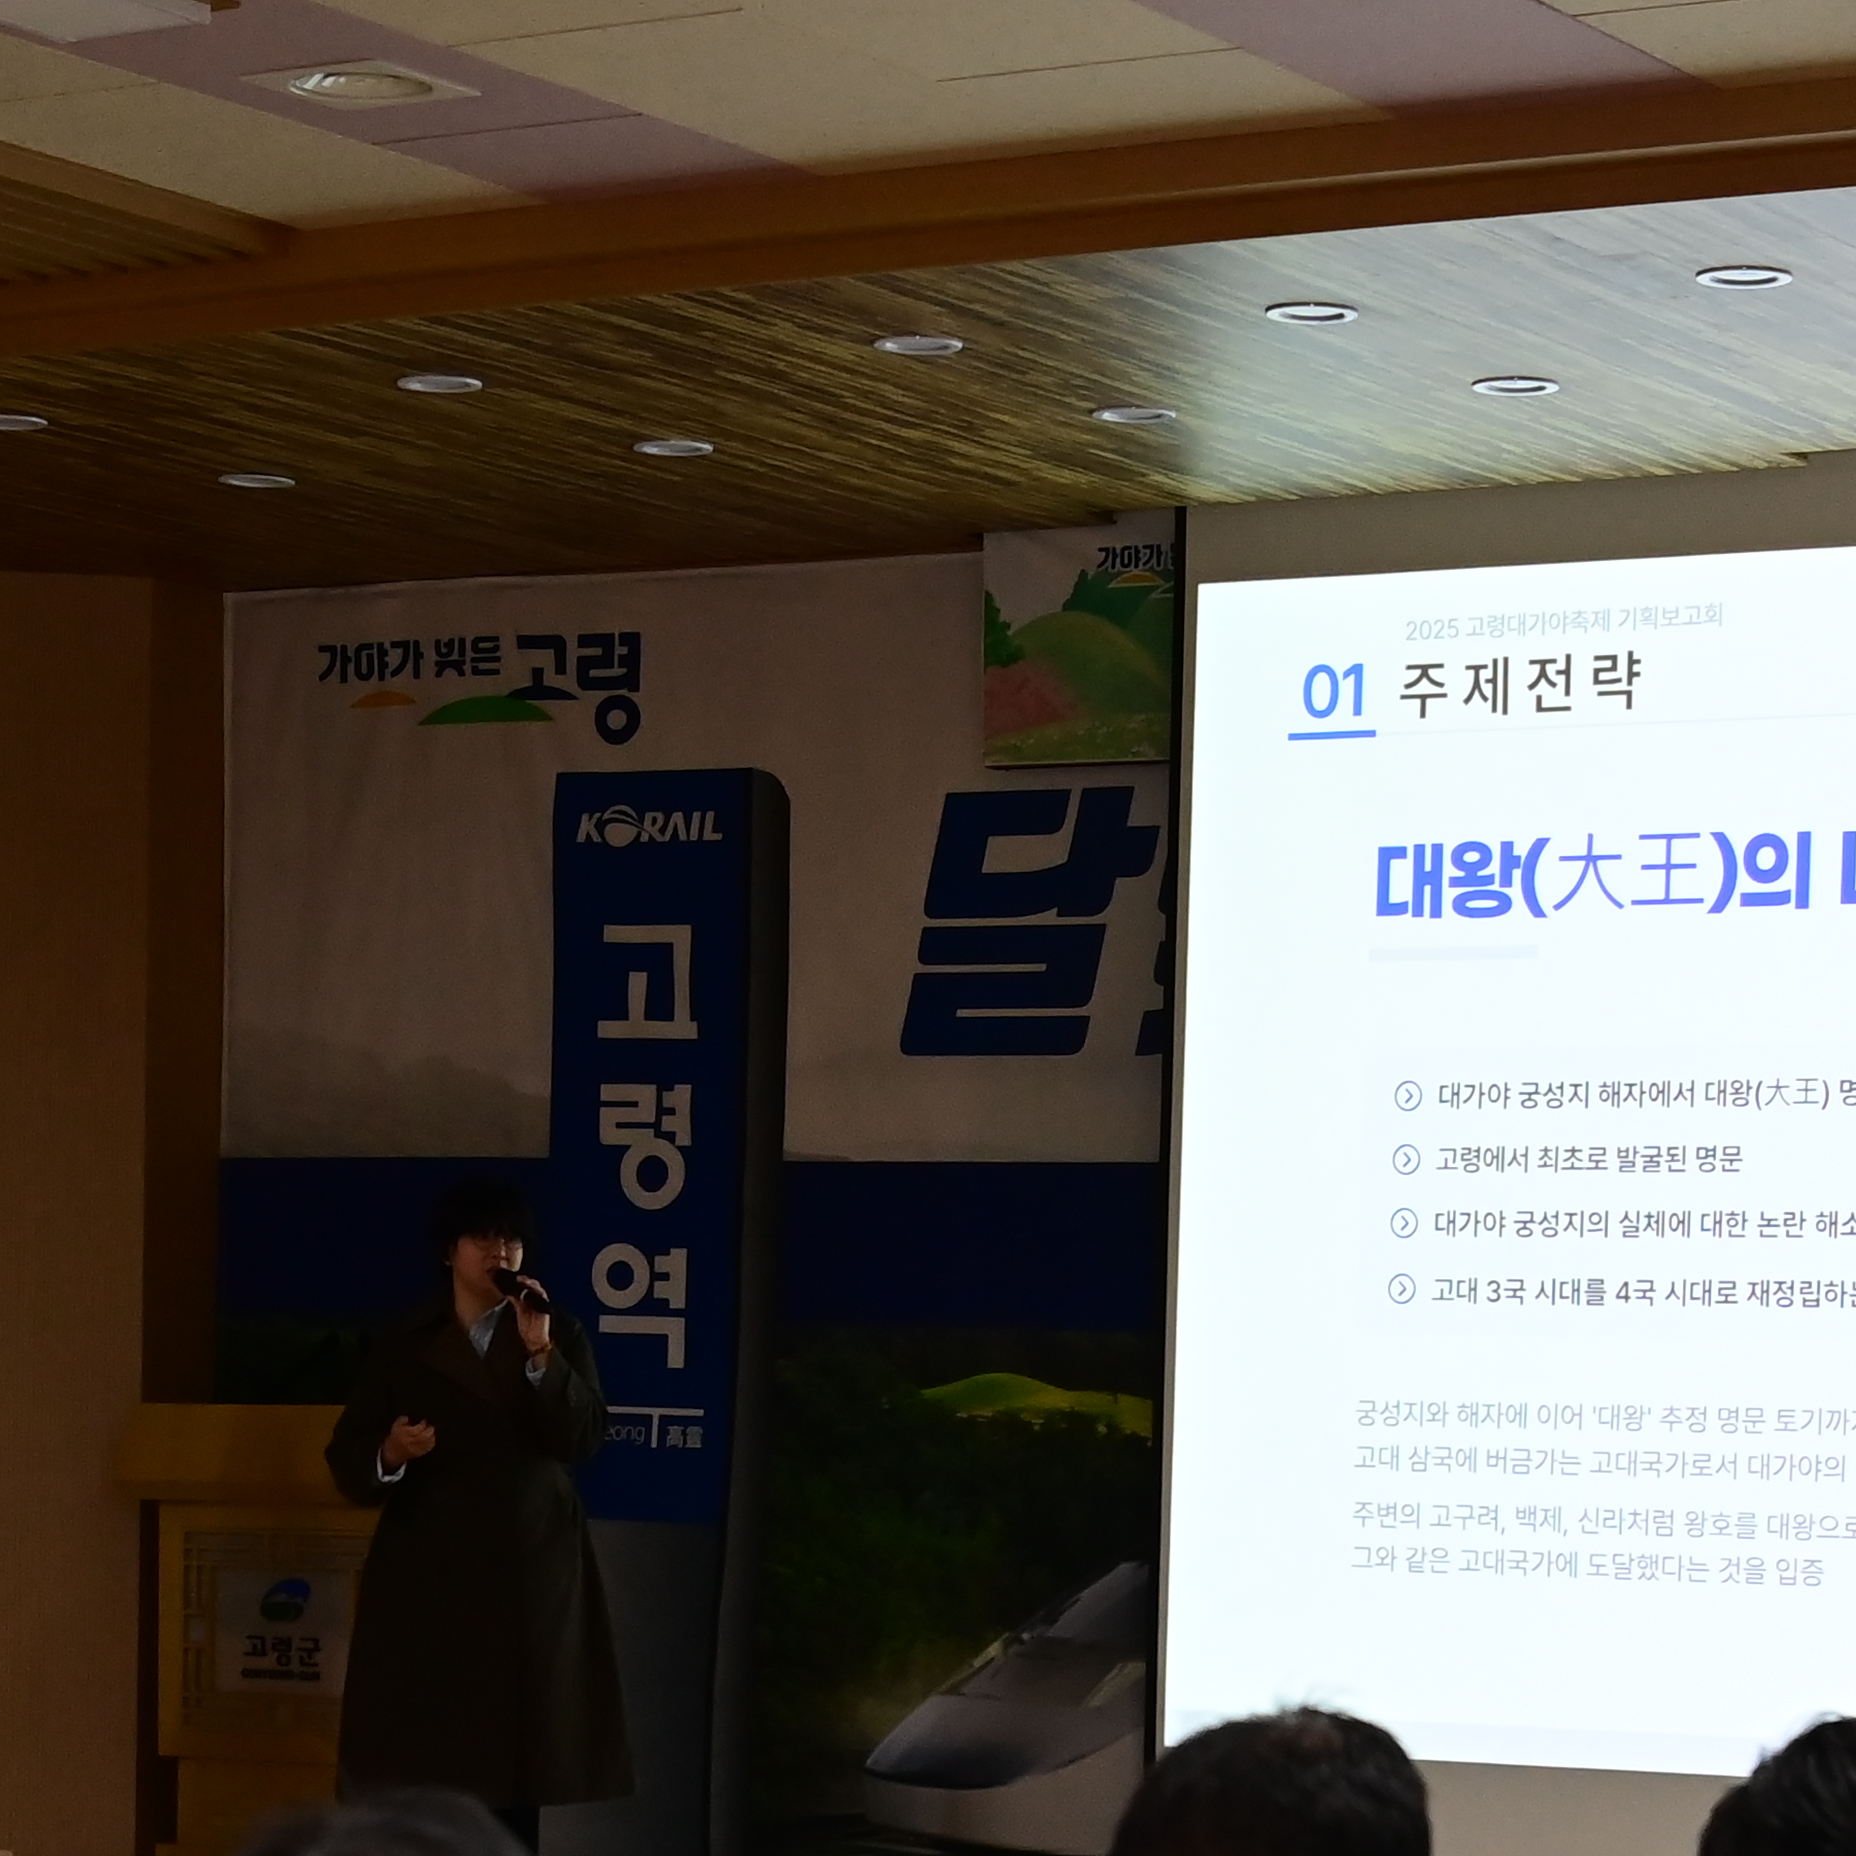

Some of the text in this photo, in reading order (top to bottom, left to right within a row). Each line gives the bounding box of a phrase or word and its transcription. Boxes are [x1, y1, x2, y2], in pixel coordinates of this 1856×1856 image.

[1405, 602, 1723, 642] 2025 고령대가야축제 기획보고회
[318, 639, 424, 683] 가야가
[505, 632, 641, 745] 고령
[1302, 650, 1642, 720] 01 주제전략
[576, 804, 723, 848] KORAIL
[1375, 830, 1813, 919] 대왕(大王)의
[900, 785, 1172, 1056] 달
[1438, 1081, 1512, 1110] 대가야
[1517, 1080, 1590, 1110] 궁성지
[1598, 1079, 1695, 1109] 해자에서
[1704, 1077, 1830, 1112] 대왕(大王)
[591, 923, 699, 1370] 고령역
[1435, 1144, 1744, 1174] 고령에서 최초로 발굴된 명문
[1434, 1209, 1507, 1239] 대가야
[1513, 1209, 1609, 1239] 궁성지의
[1618, 1209, 1692, 1239] 실체에
[1700, 1210, 1749, 1239] 대한
[1756, 1210, 1808, 1239] 논란
[1431, 1277, 1478, 1305] 고대
[1486, 1278, 1527, 1306] 3국
[1534, 1277, 1607, 1307] 시대를
[1615, 1279, 1657, 1307] 4국
[1664, 1278, 1739, 1308] 시대로
[1355, 1399, 1450, 1429] 궁성지와
[1456, 1401, 1528, 1430] 해자에
[1536, 1402, 1583, 1431] 이어
[1592, 1403, 1652, 1432] '대왕'
[1659, 1405, 1708, 1434] 추정
[1717, 1405, 1767, 1435] 명문
[1353, 1444, 1400, 1472] 고대
[1408, 1444, 1478, 1474] 삼국에
[1486, 1446, 1582, 1477] 버금가는
[1589, 1449, 1738, 1481] 고대국가로서
[1747, 1452, 1846, 1483] 대가야의
[1352, 1501, 1421, 1530] 주변의
[1428, 1503, 1506, 1536] 고구려,
[1515, 1504, 1568, 1538] 백제,
[1578, 1506, 1674, 1538] 신라처럼
[1683, 1510, 1759, 1540] 왕호를
[1351, 1544, 1825, 1587] 그와 같은 고대국가에 도달했다는 것을 입증
[242, 1634, 322, 1667] 고령군
